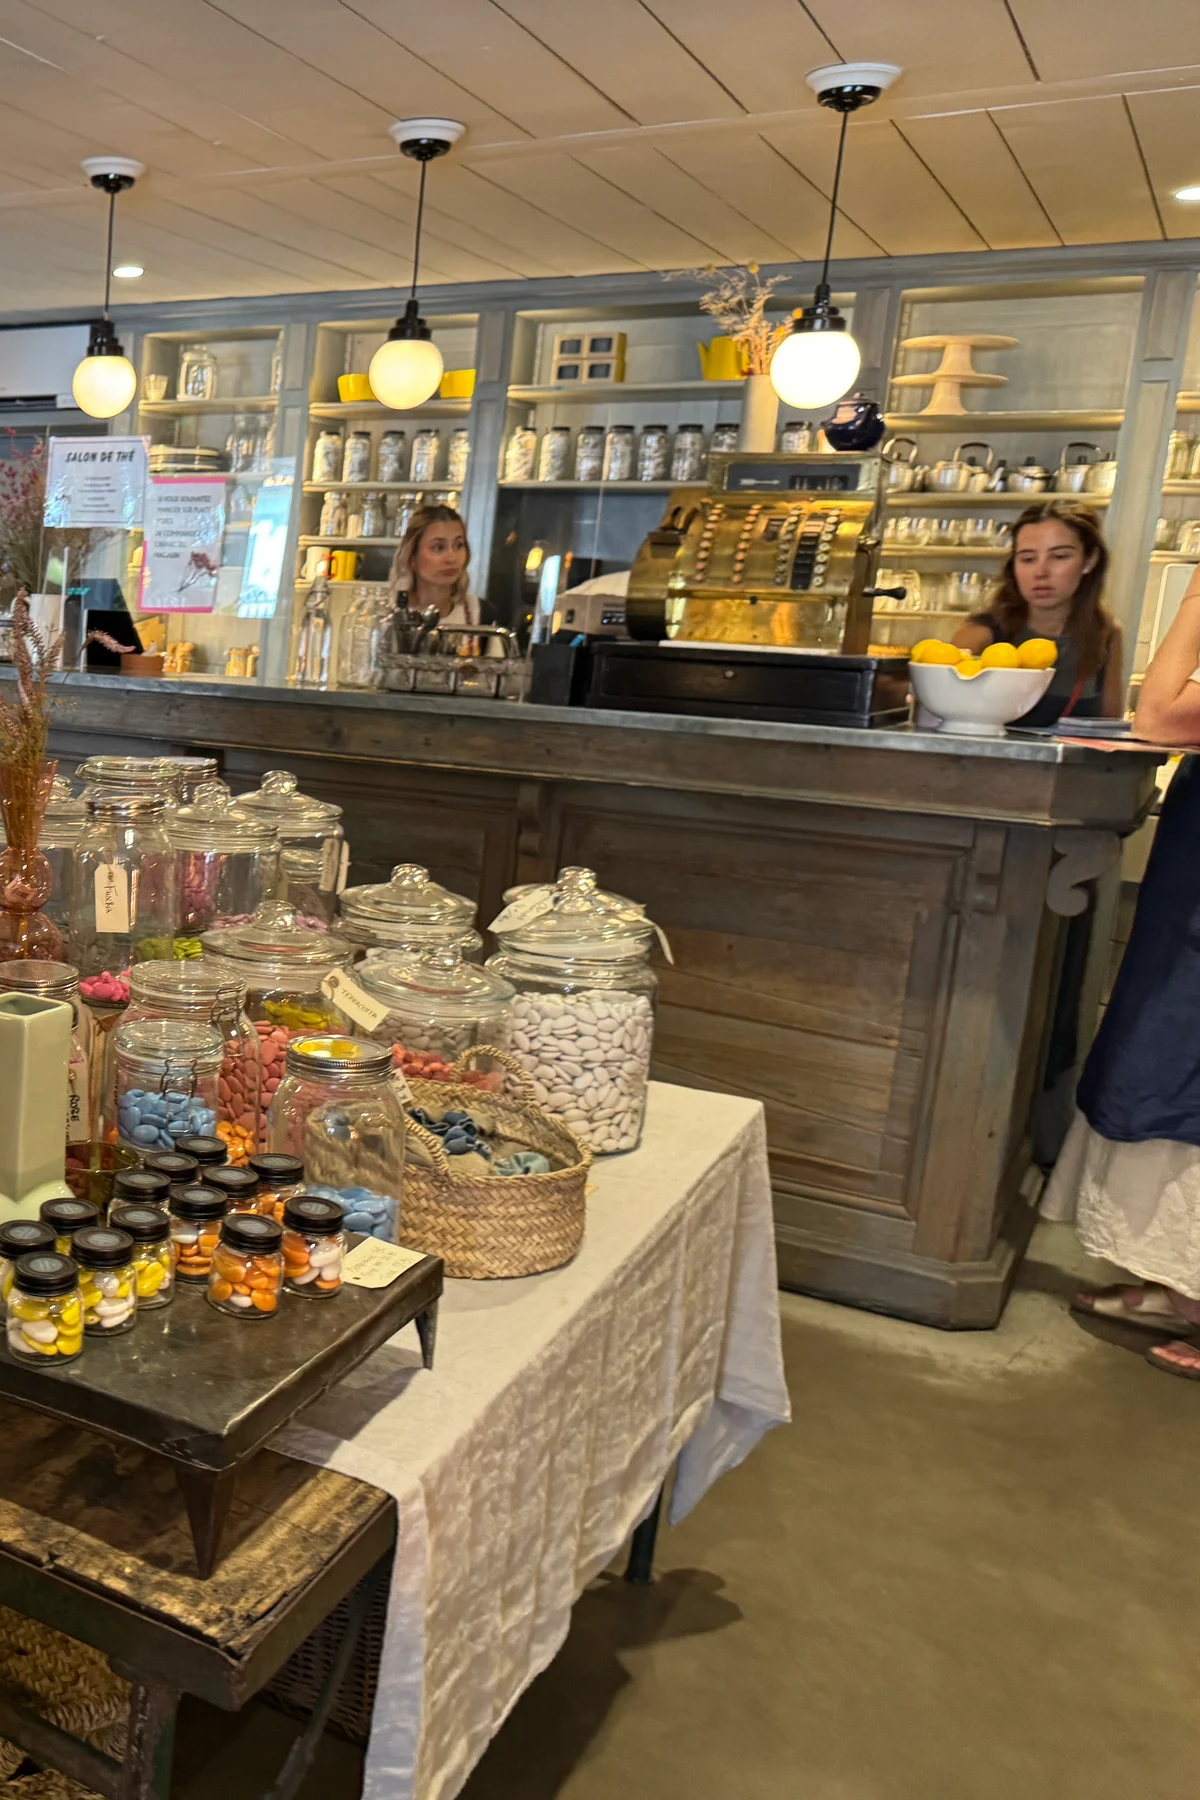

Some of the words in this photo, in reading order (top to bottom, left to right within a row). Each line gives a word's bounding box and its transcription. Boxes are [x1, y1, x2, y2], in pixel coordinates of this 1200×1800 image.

[65, 451, 98, 463] SALON
[100, 451, 114, 462] DE
[116, 448, 136, 462] THÉ
[69, 1094, 80, 1122] ROSE
